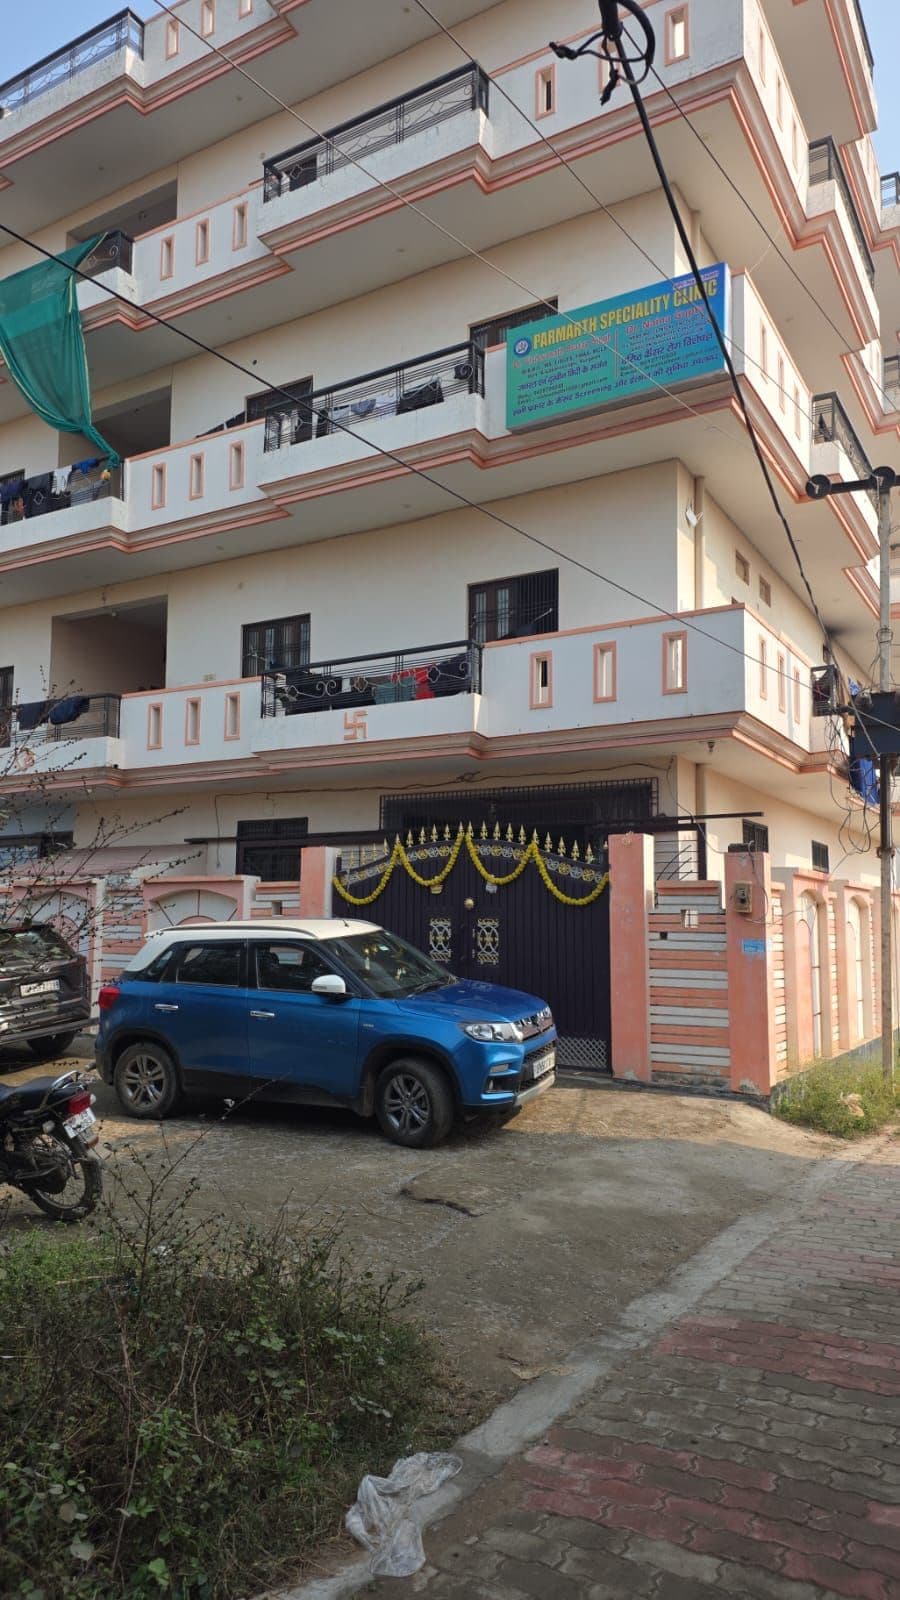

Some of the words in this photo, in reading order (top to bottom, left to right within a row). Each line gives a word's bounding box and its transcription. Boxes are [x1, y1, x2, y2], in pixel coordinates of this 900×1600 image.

[533, 315, 597, 350] PARMARTH
[600, 293, 670, 330] SPECIALITY
[673, 279, 717, 308] CLINIC
[575, 384, 612, 400] Screening
